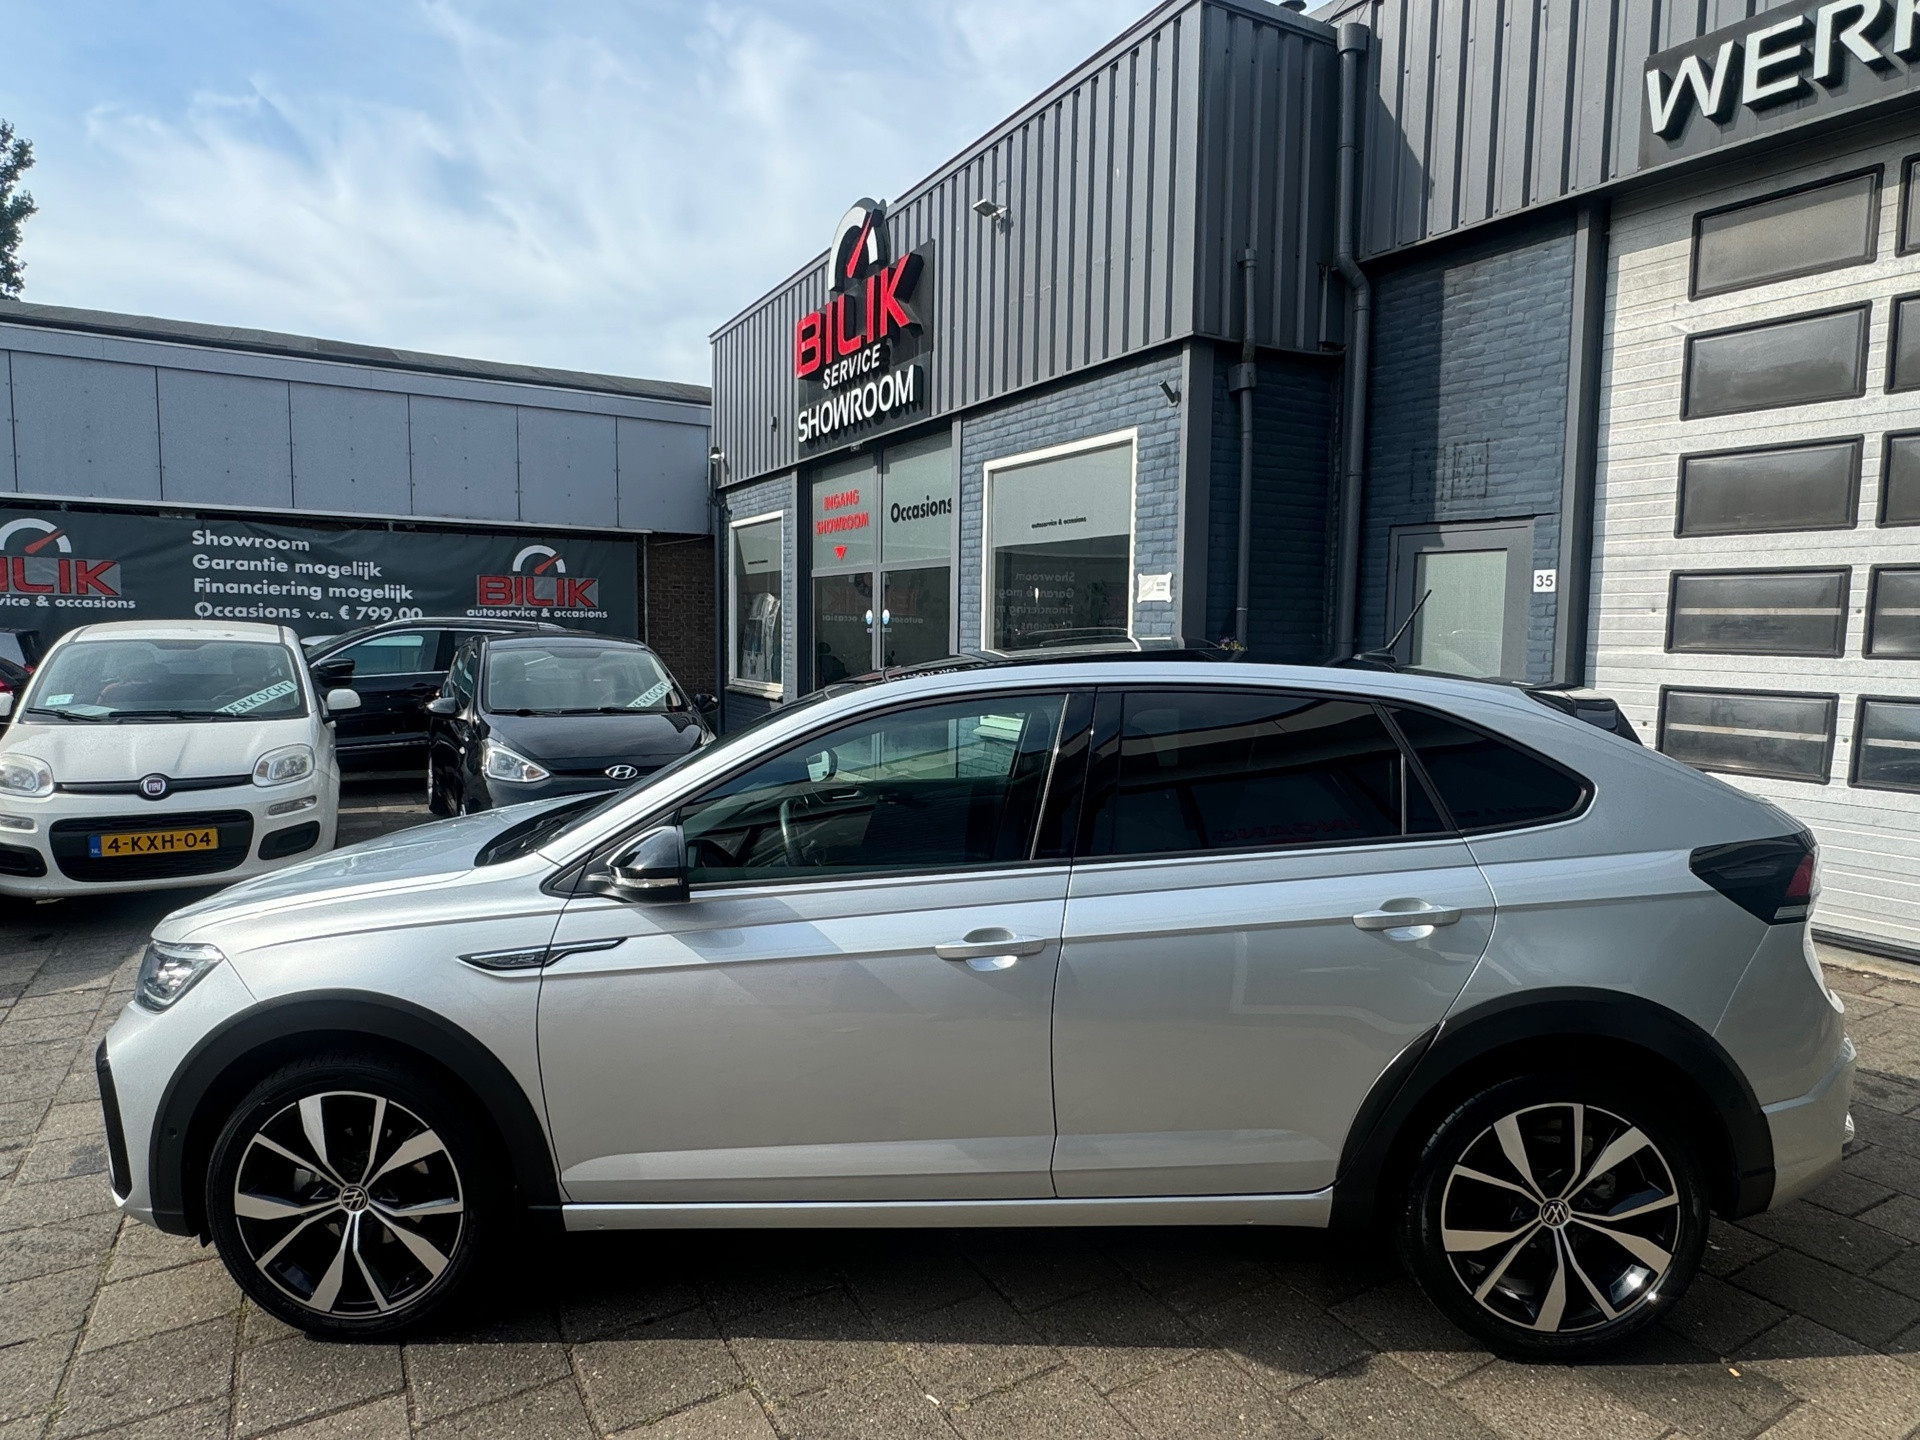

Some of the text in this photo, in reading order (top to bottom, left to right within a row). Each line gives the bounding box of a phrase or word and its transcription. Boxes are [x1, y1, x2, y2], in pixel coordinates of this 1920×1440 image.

[796, 253, 912, 378] BILIK
[823, 343, 881, 390] SERVICE
[798, 364, 914, 443] SHOWROOM
[823, 488, 860, 511] INGANG
[815, 511, 870, 536] SHOWROOM
[192, 529, 310, 551] Showroom
[192, 554, 382, 580] Garantie mogelijk
[193, 577, 413, 603] Financiering mogelijk
[479, 575, 598, 607] BILIK
[1536, 575, 1553, 588] 35
[36, 595, 50, 607] &
[55, 597, 136, 609] occasions
[194, 601, 423, 620] Occasions v.a. € 799,00
[466, 607, 608, 618] autoservice & occasions
[108, 832, 211, 853] 4-KXH-04
